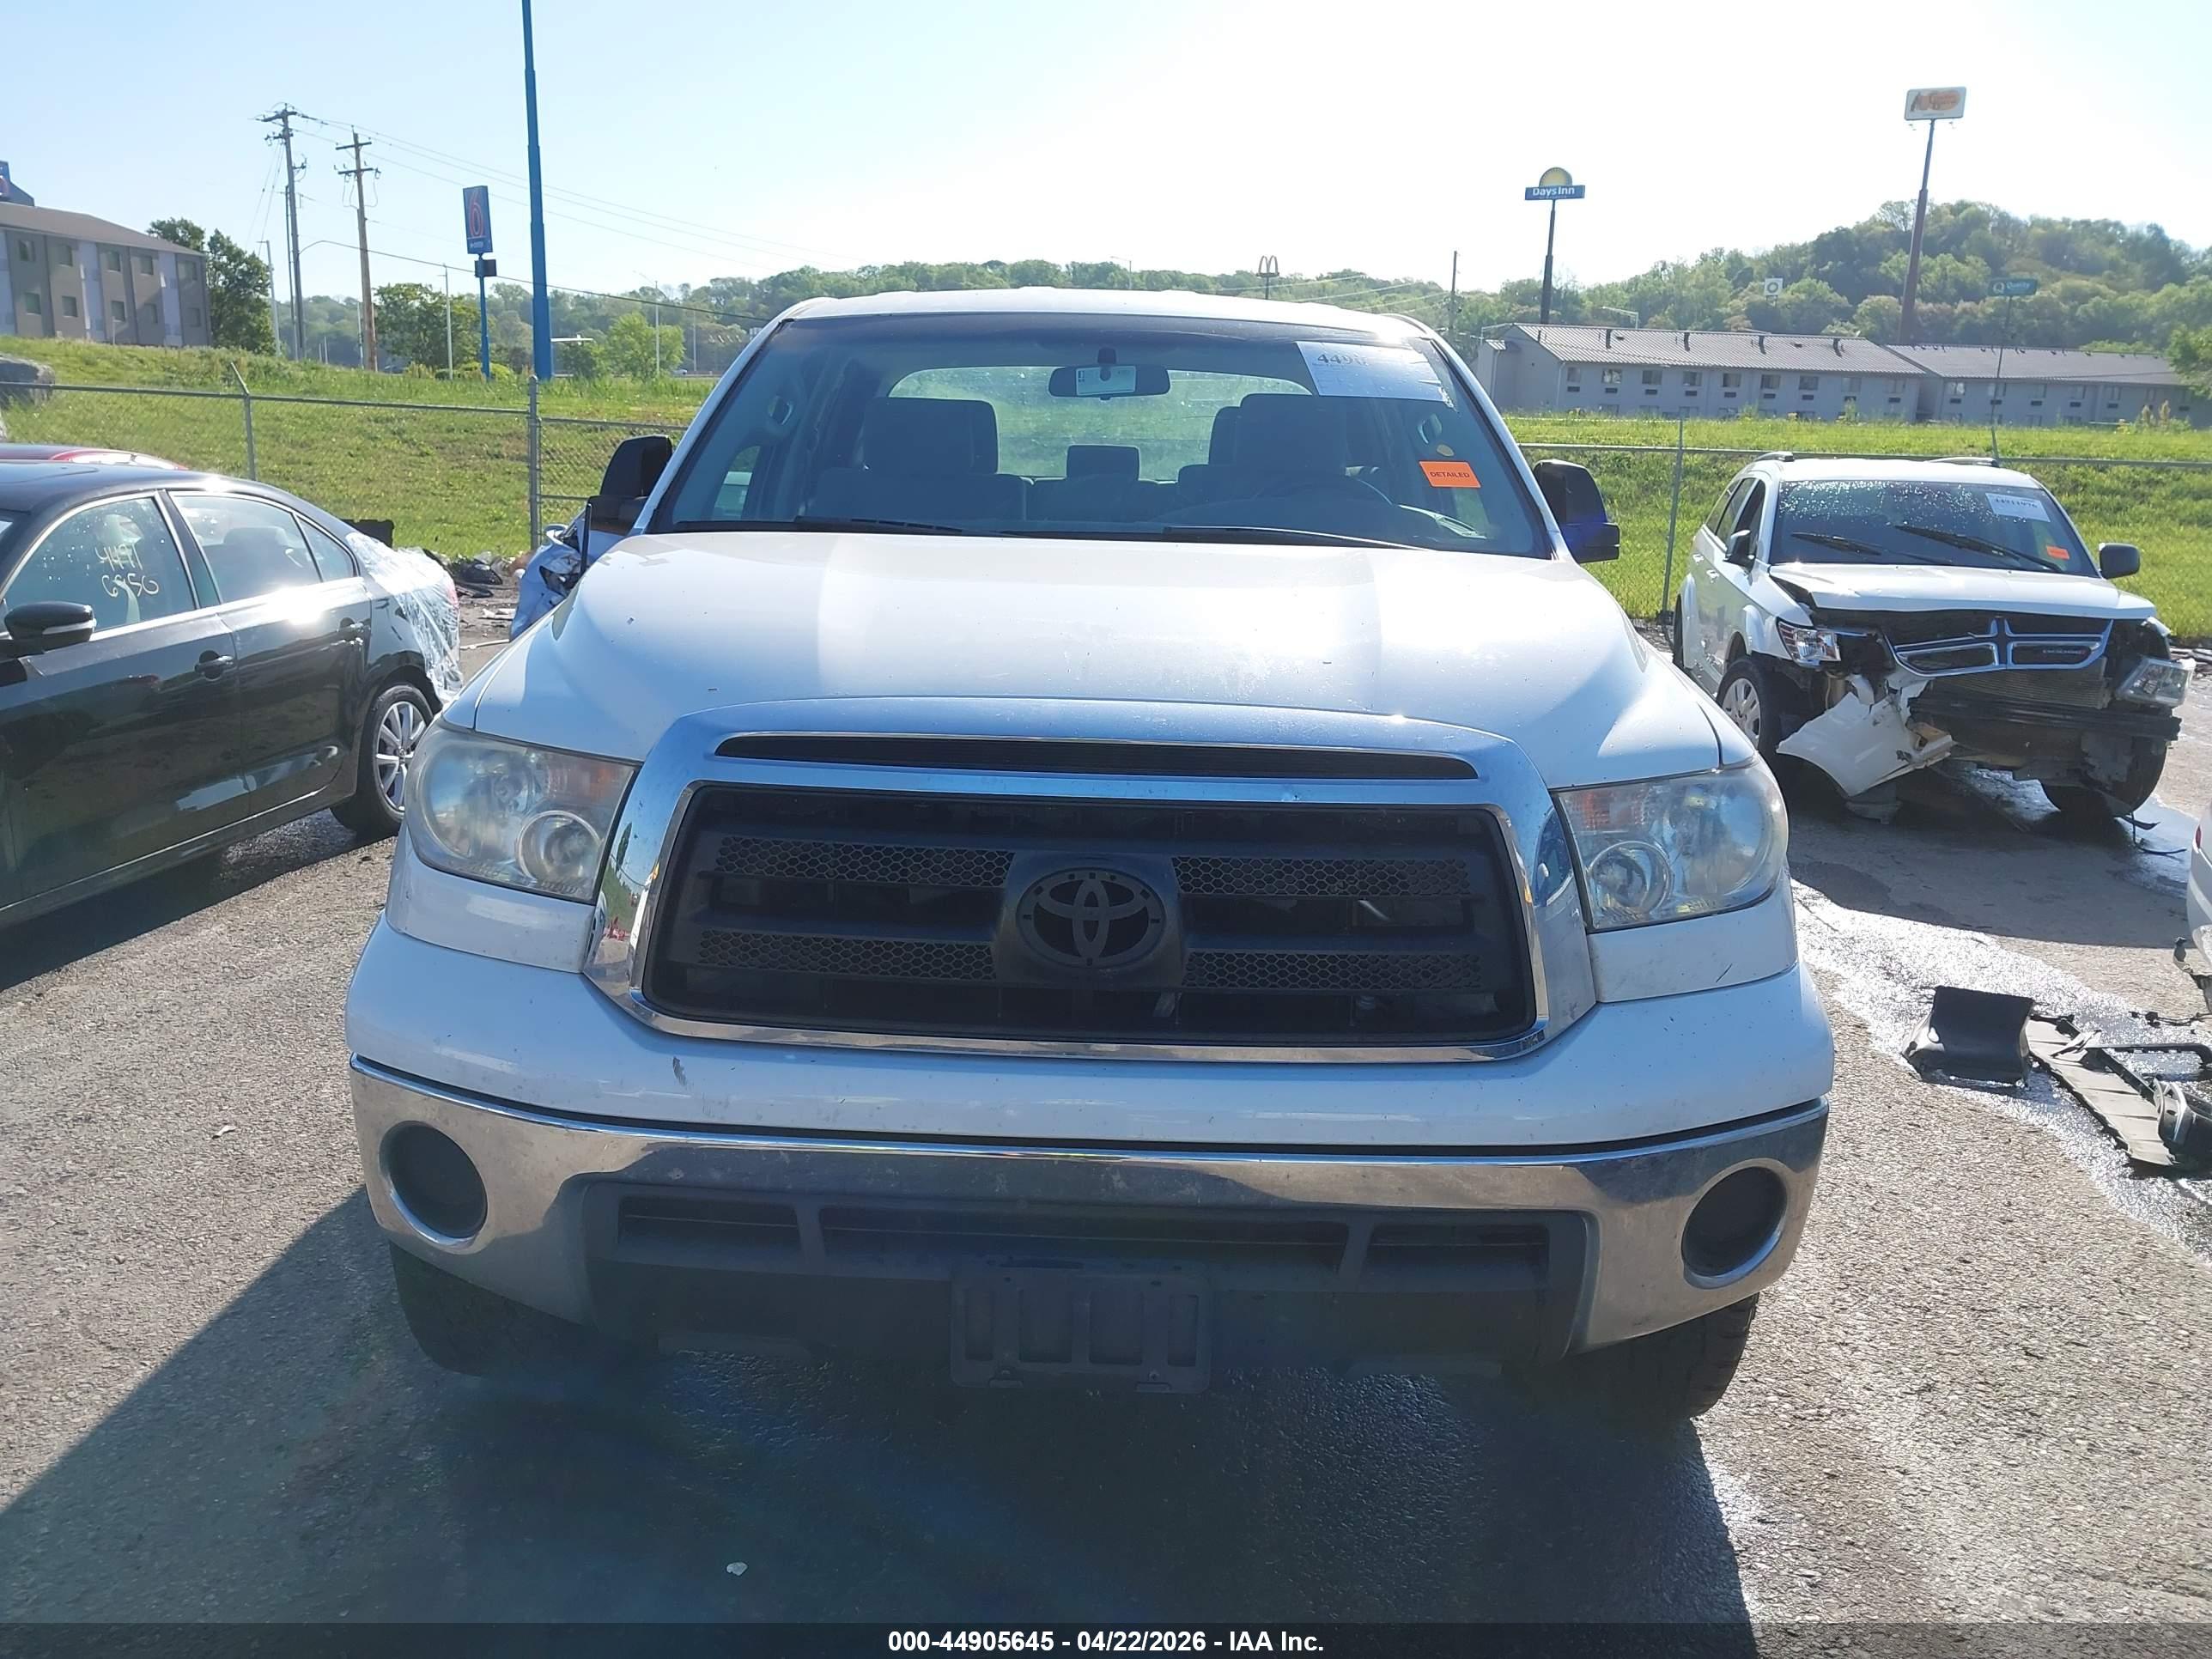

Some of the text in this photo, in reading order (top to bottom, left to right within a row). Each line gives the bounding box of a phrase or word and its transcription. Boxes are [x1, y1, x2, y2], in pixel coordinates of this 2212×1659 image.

[1532, 186, 1576, 197] Days Inn
[470, 190, 483, 237] 6
